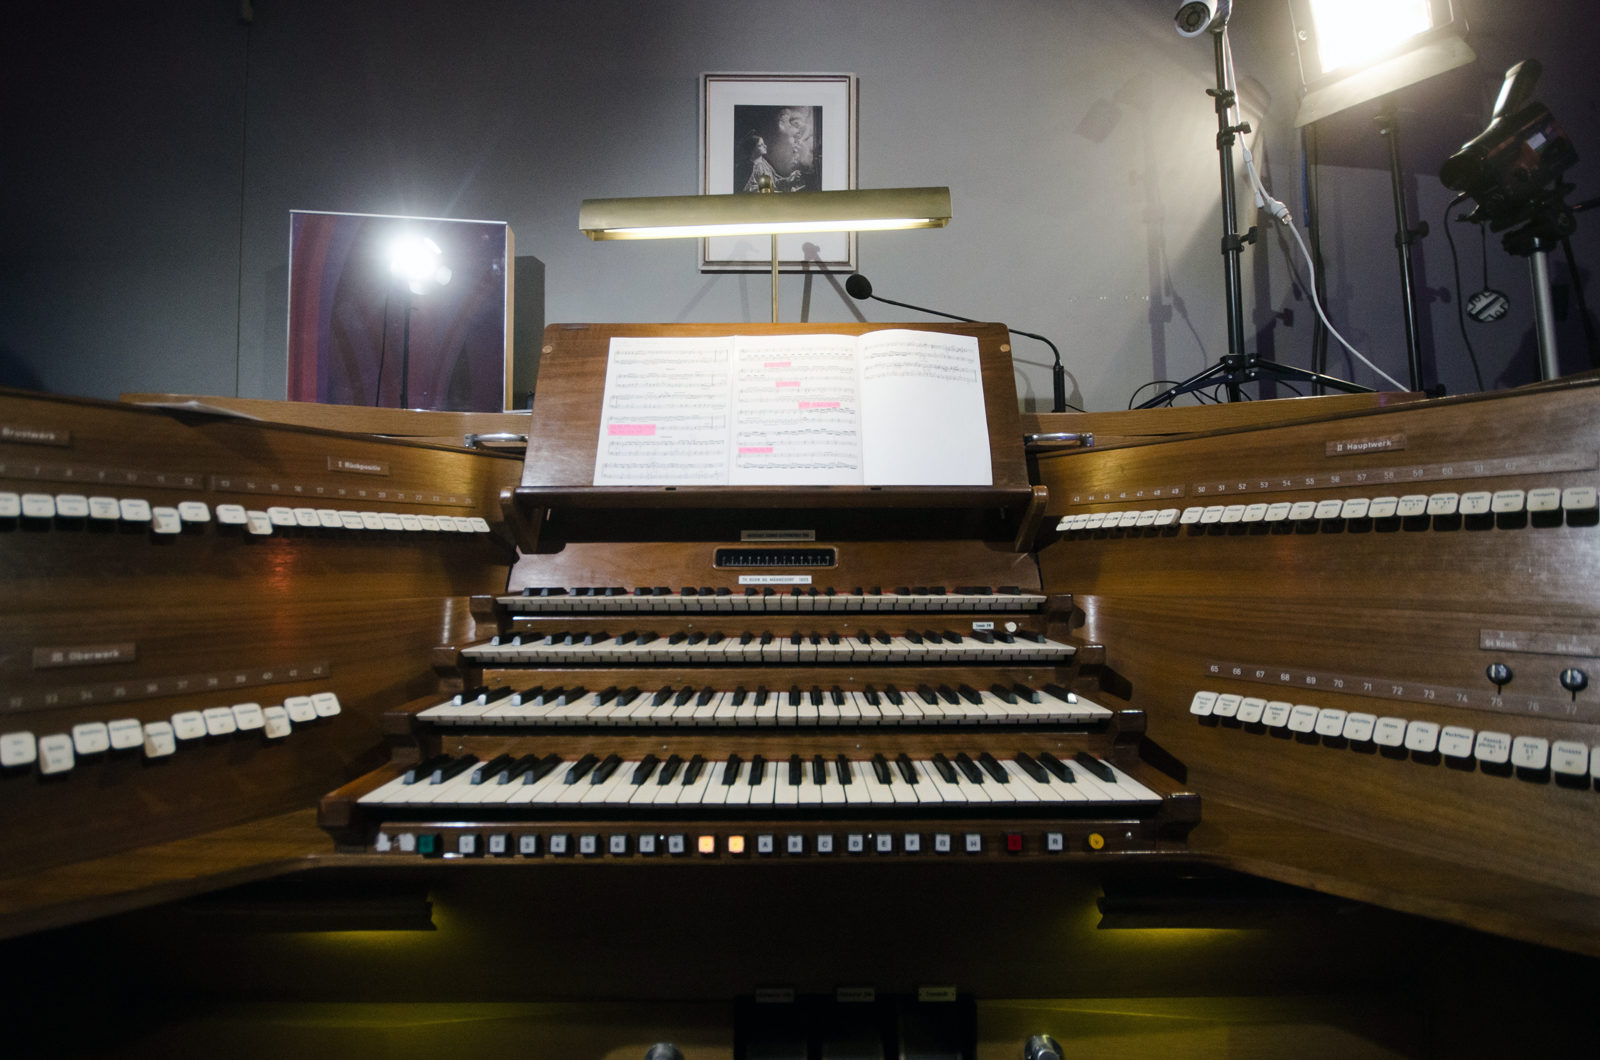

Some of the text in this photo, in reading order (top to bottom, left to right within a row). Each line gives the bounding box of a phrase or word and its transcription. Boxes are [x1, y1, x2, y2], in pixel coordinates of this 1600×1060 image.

[1347, 440, 1392, 450] Hauptwerk
[1442, 467, 1453, 475] 60
[1306, 676, 1316, 684] 69
[1333, 679, 1343, 688] 70
[1363, 682, 1372, 691] 71
[1392, 686, 1403, 696] 72
[1423, 689, 1435, 699] 73
[1456, 693, 1468, 703] 74
[1491, 697, 1503, 707] 75
[1528, 701, 1539, 712] 76
[1565, 704, 1578, 715] 77
